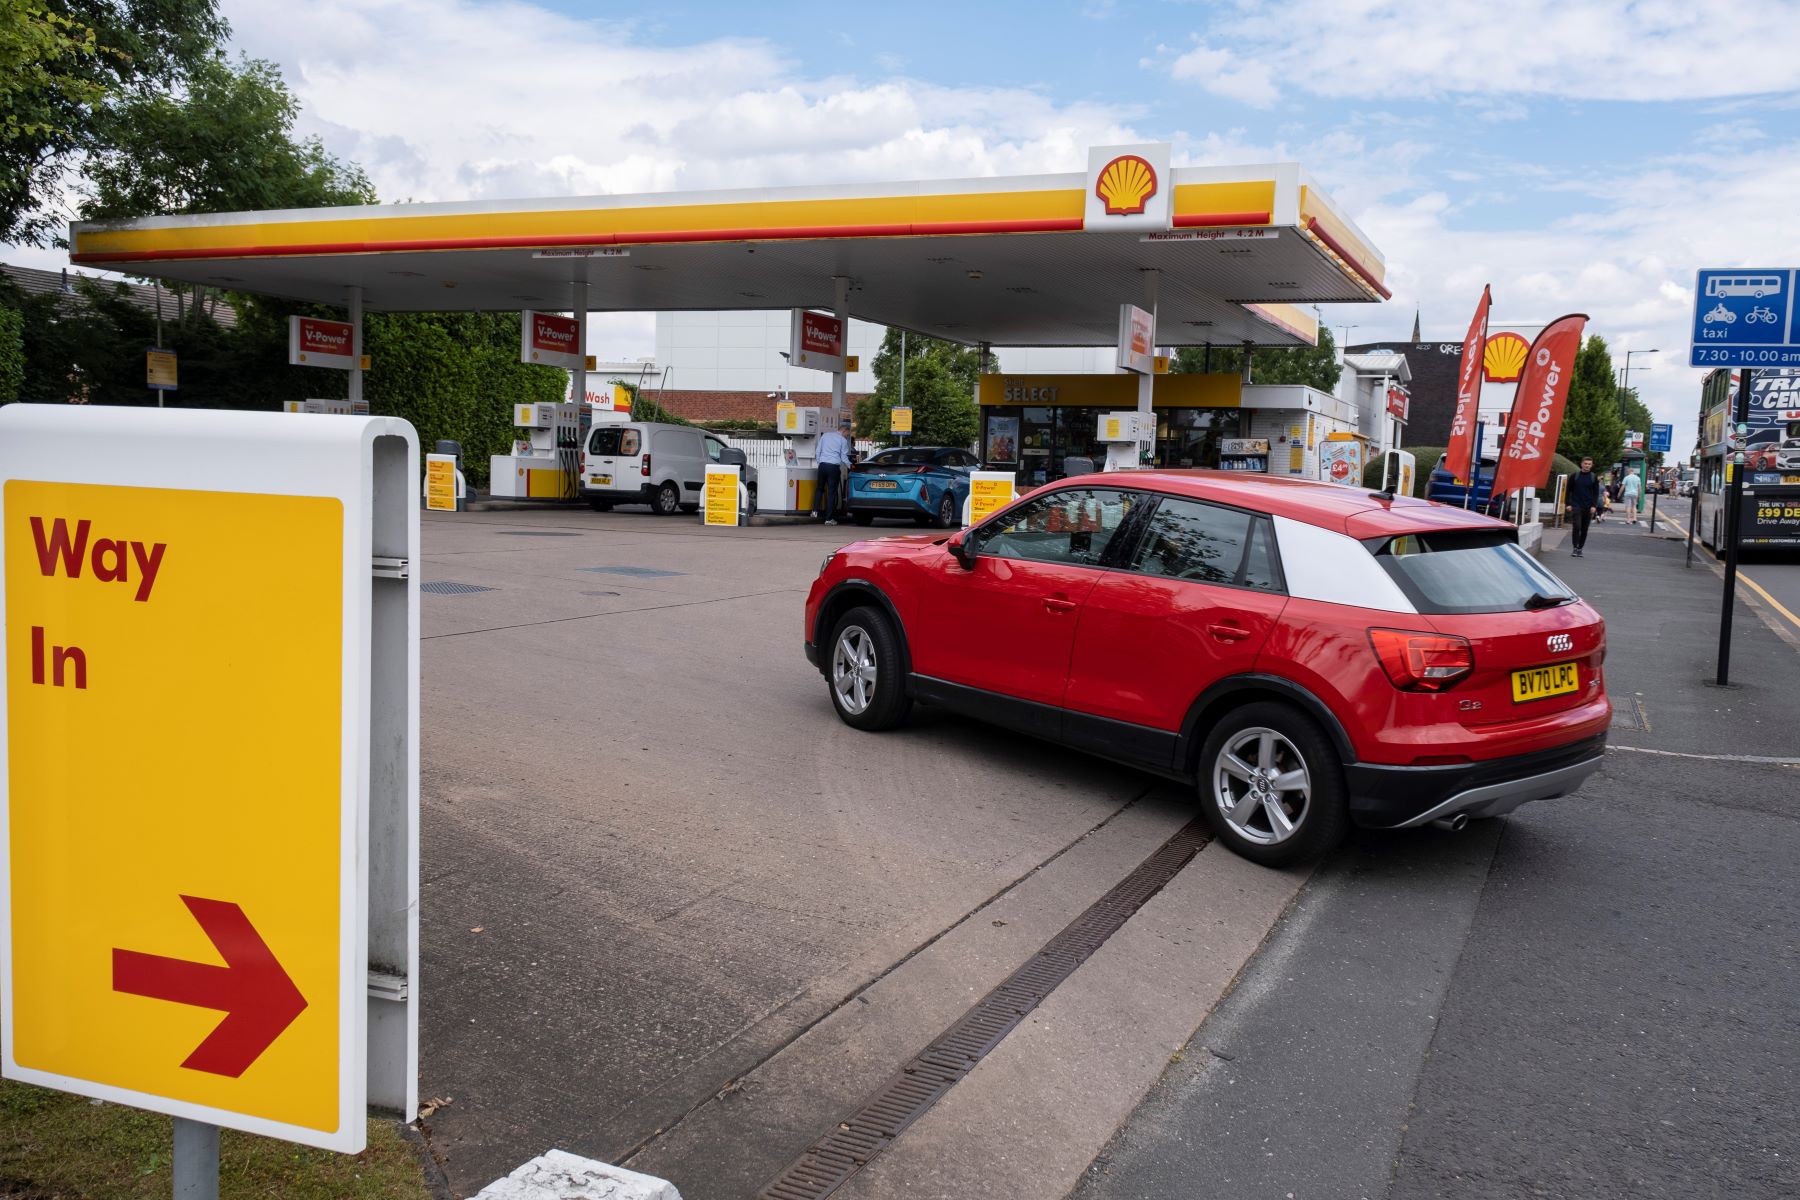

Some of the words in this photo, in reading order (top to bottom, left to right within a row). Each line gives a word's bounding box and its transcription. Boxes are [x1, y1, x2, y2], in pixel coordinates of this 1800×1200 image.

[1148, 232, 1192, 241] Maximum
[1196, 231, 1225, 240] Height
[540, 249, 572, 257] Maximum
[574, 248, 595, 258] Height
[305, 330, 346, 345] V-Power
[538, 325, 574, 342] V-Power
[806, 326, 837, 343] V-Power
[1702, 327, 1728, 339] taxi
[848, 359, 854, 368] 3
[1698, 350, 1729, 361] 7.30
[1740, 350, 1779, 362] 10.00
[585, 391, 611, 405] Wash
[1003, 387, 1058, 402] SELECT
[1521, 360, 1561, 461] V-Power
[1508, 419, 1529, 460] Shell
[1757, 507, 1781, 518] £99
[1779, 518, 1800, 526] Away
[29, 516, 168, 602] Way
[31, 625, 87, 689] In
[1520, 670, 1550, 695] BV70
[1553, 665, 1574, 689] LPC
